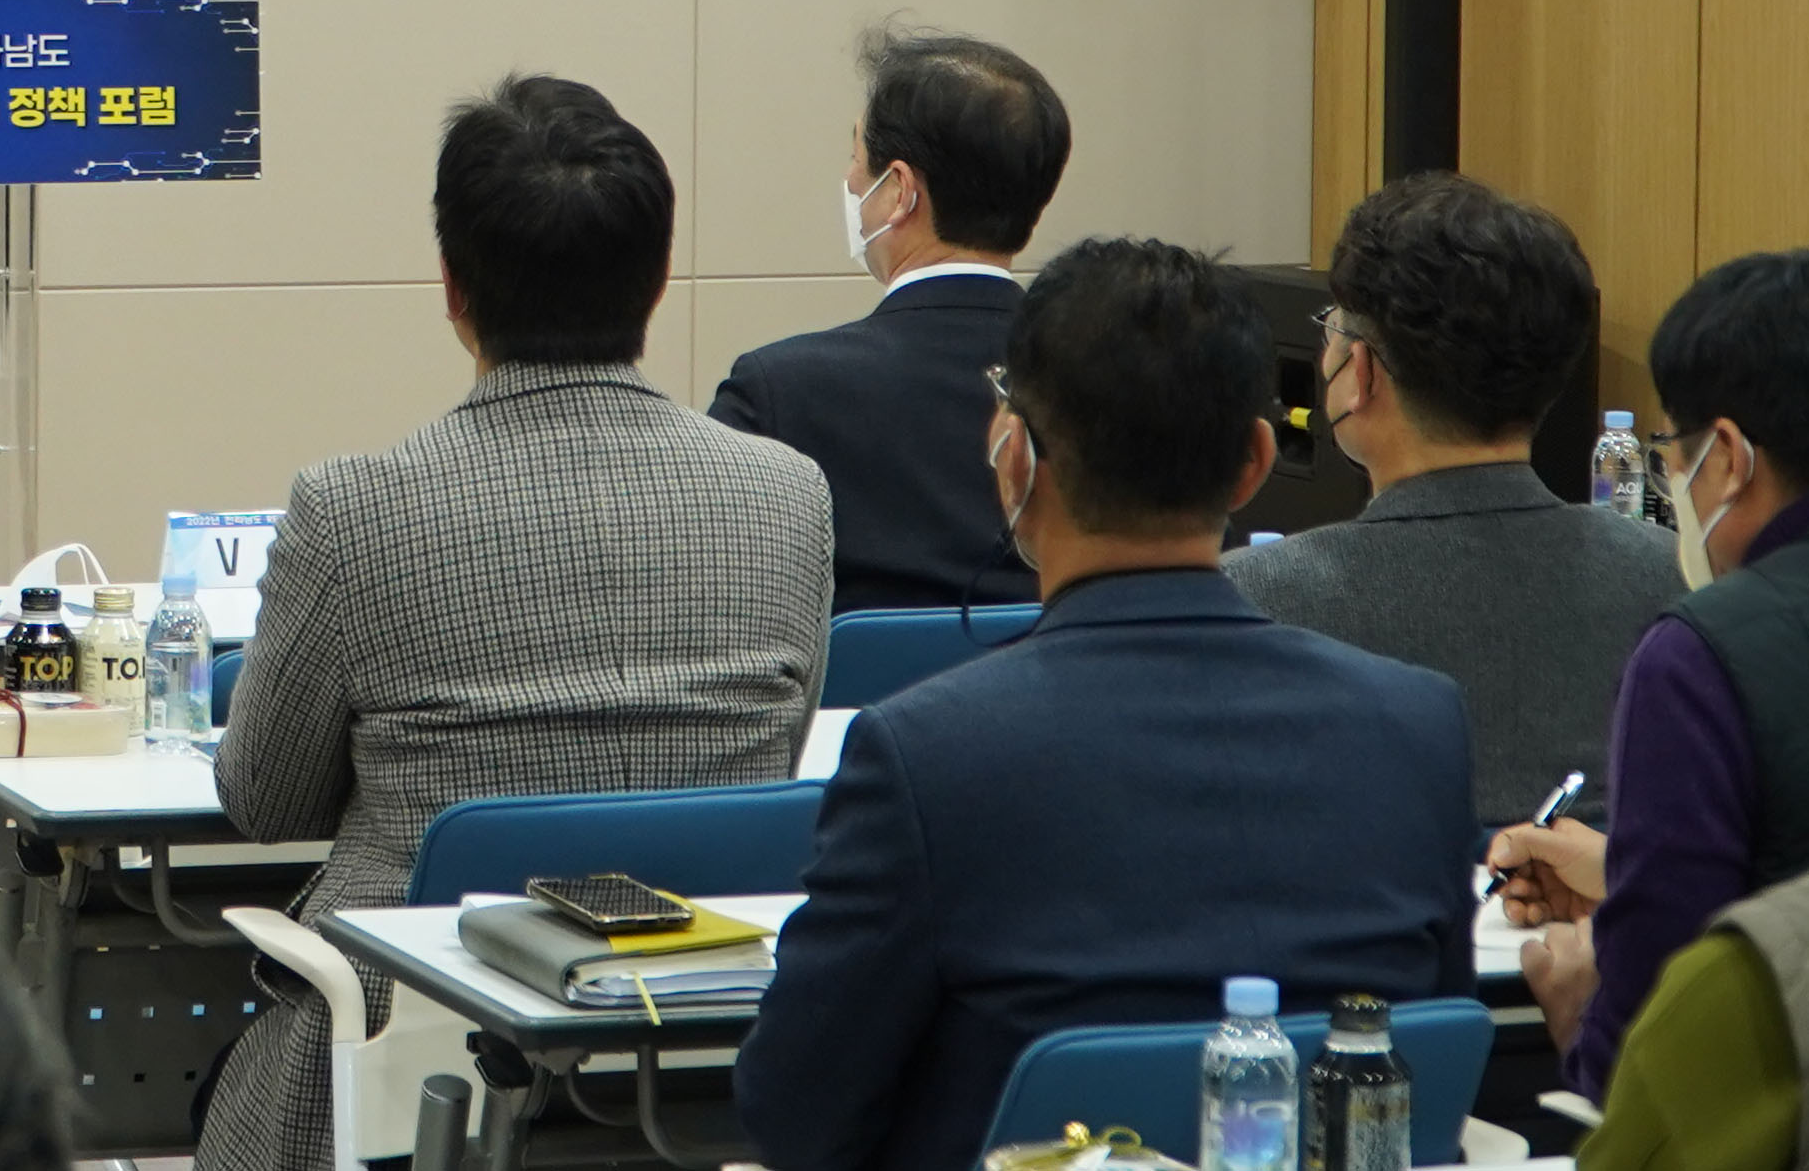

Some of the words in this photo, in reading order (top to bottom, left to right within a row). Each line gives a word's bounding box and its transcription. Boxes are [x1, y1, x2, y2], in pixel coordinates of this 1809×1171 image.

[8, 87, 86, 128] 정책
[98, 86, 177, 127] 포럼
[215, 537, 239, 577] V
[20, 655, 74, 682] T.O.P
